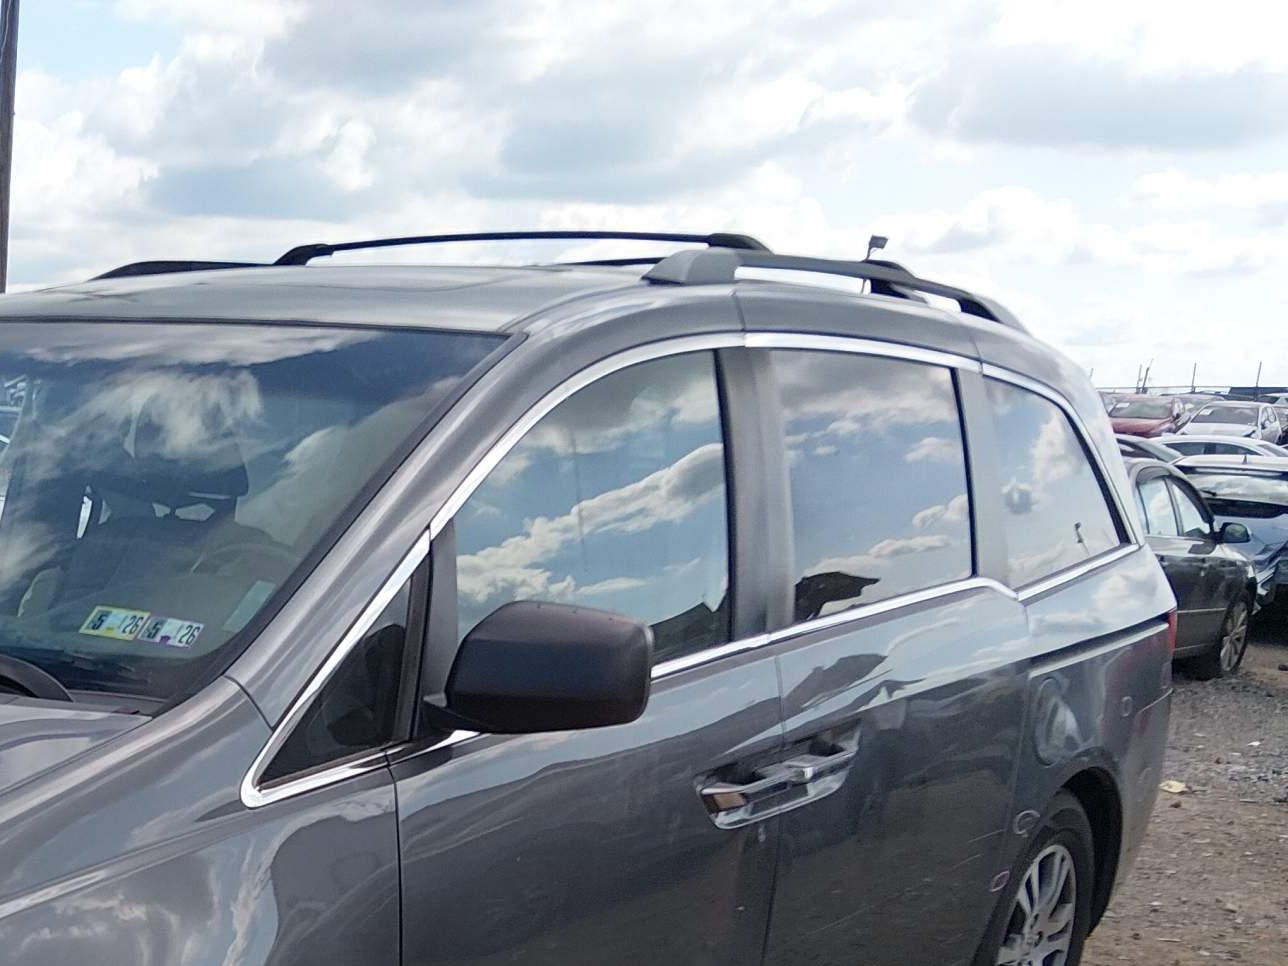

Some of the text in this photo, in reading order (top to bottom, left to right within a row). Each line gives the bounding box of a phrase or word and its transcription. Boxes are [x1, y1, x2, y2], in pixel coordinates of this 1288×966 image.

[93, 614, 144, 635] 5 26
[147, 621, 201, 646] 5 26
